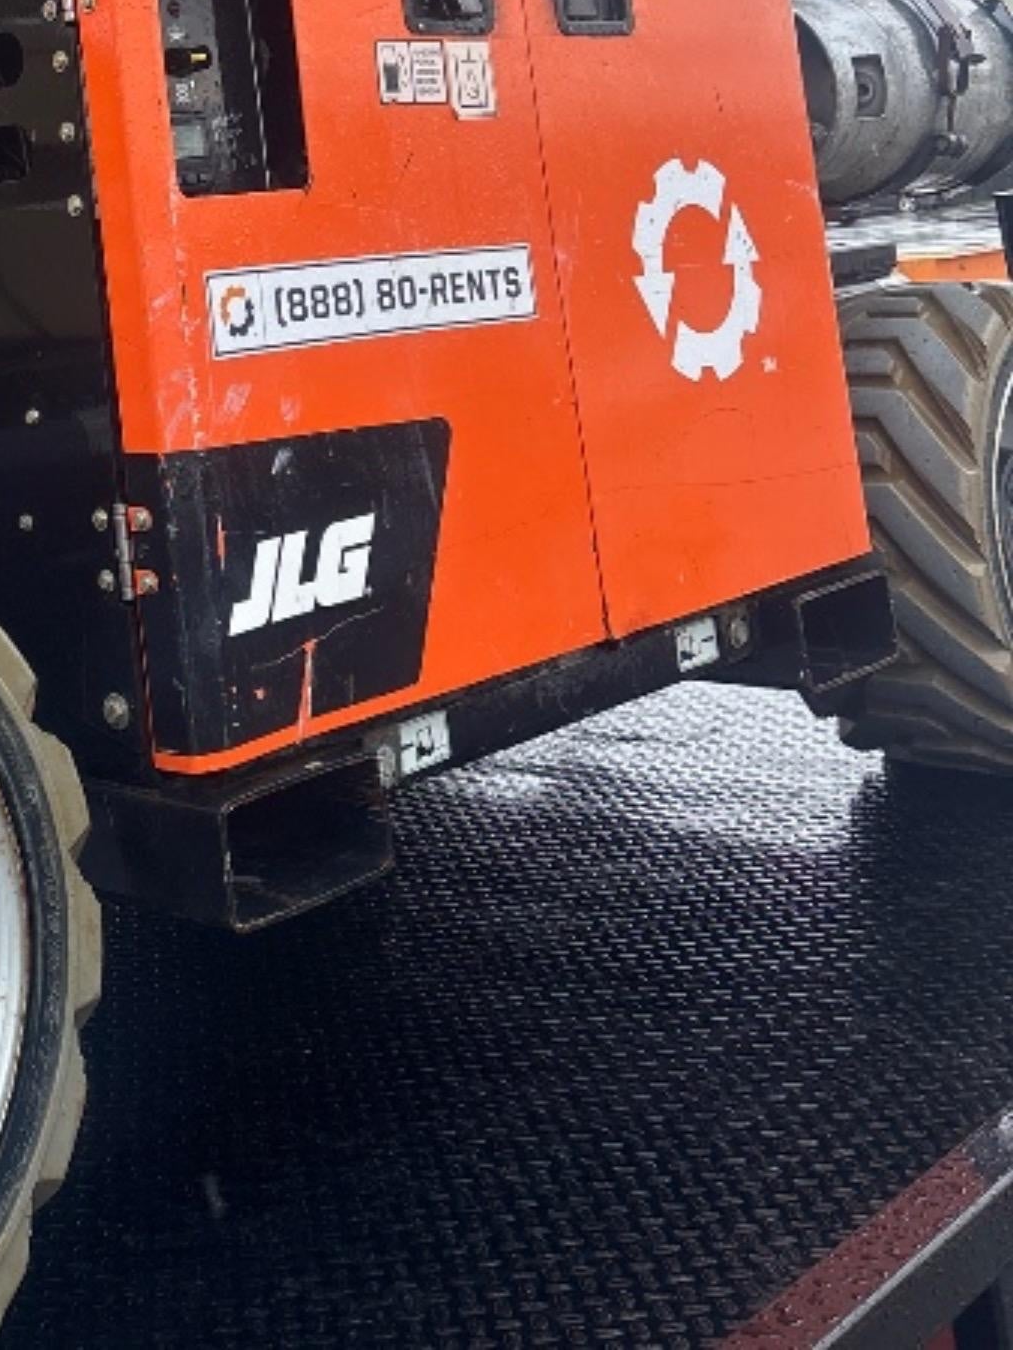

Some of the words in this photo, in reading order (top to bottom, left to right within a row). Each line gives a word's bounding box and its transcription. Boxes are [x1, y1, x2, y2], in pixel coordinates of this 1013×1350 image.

[274, 278, 366, 328] (888)
[376, 266, 522, 312] 80-RENTS
[228, 512, 376, 637] JLG
